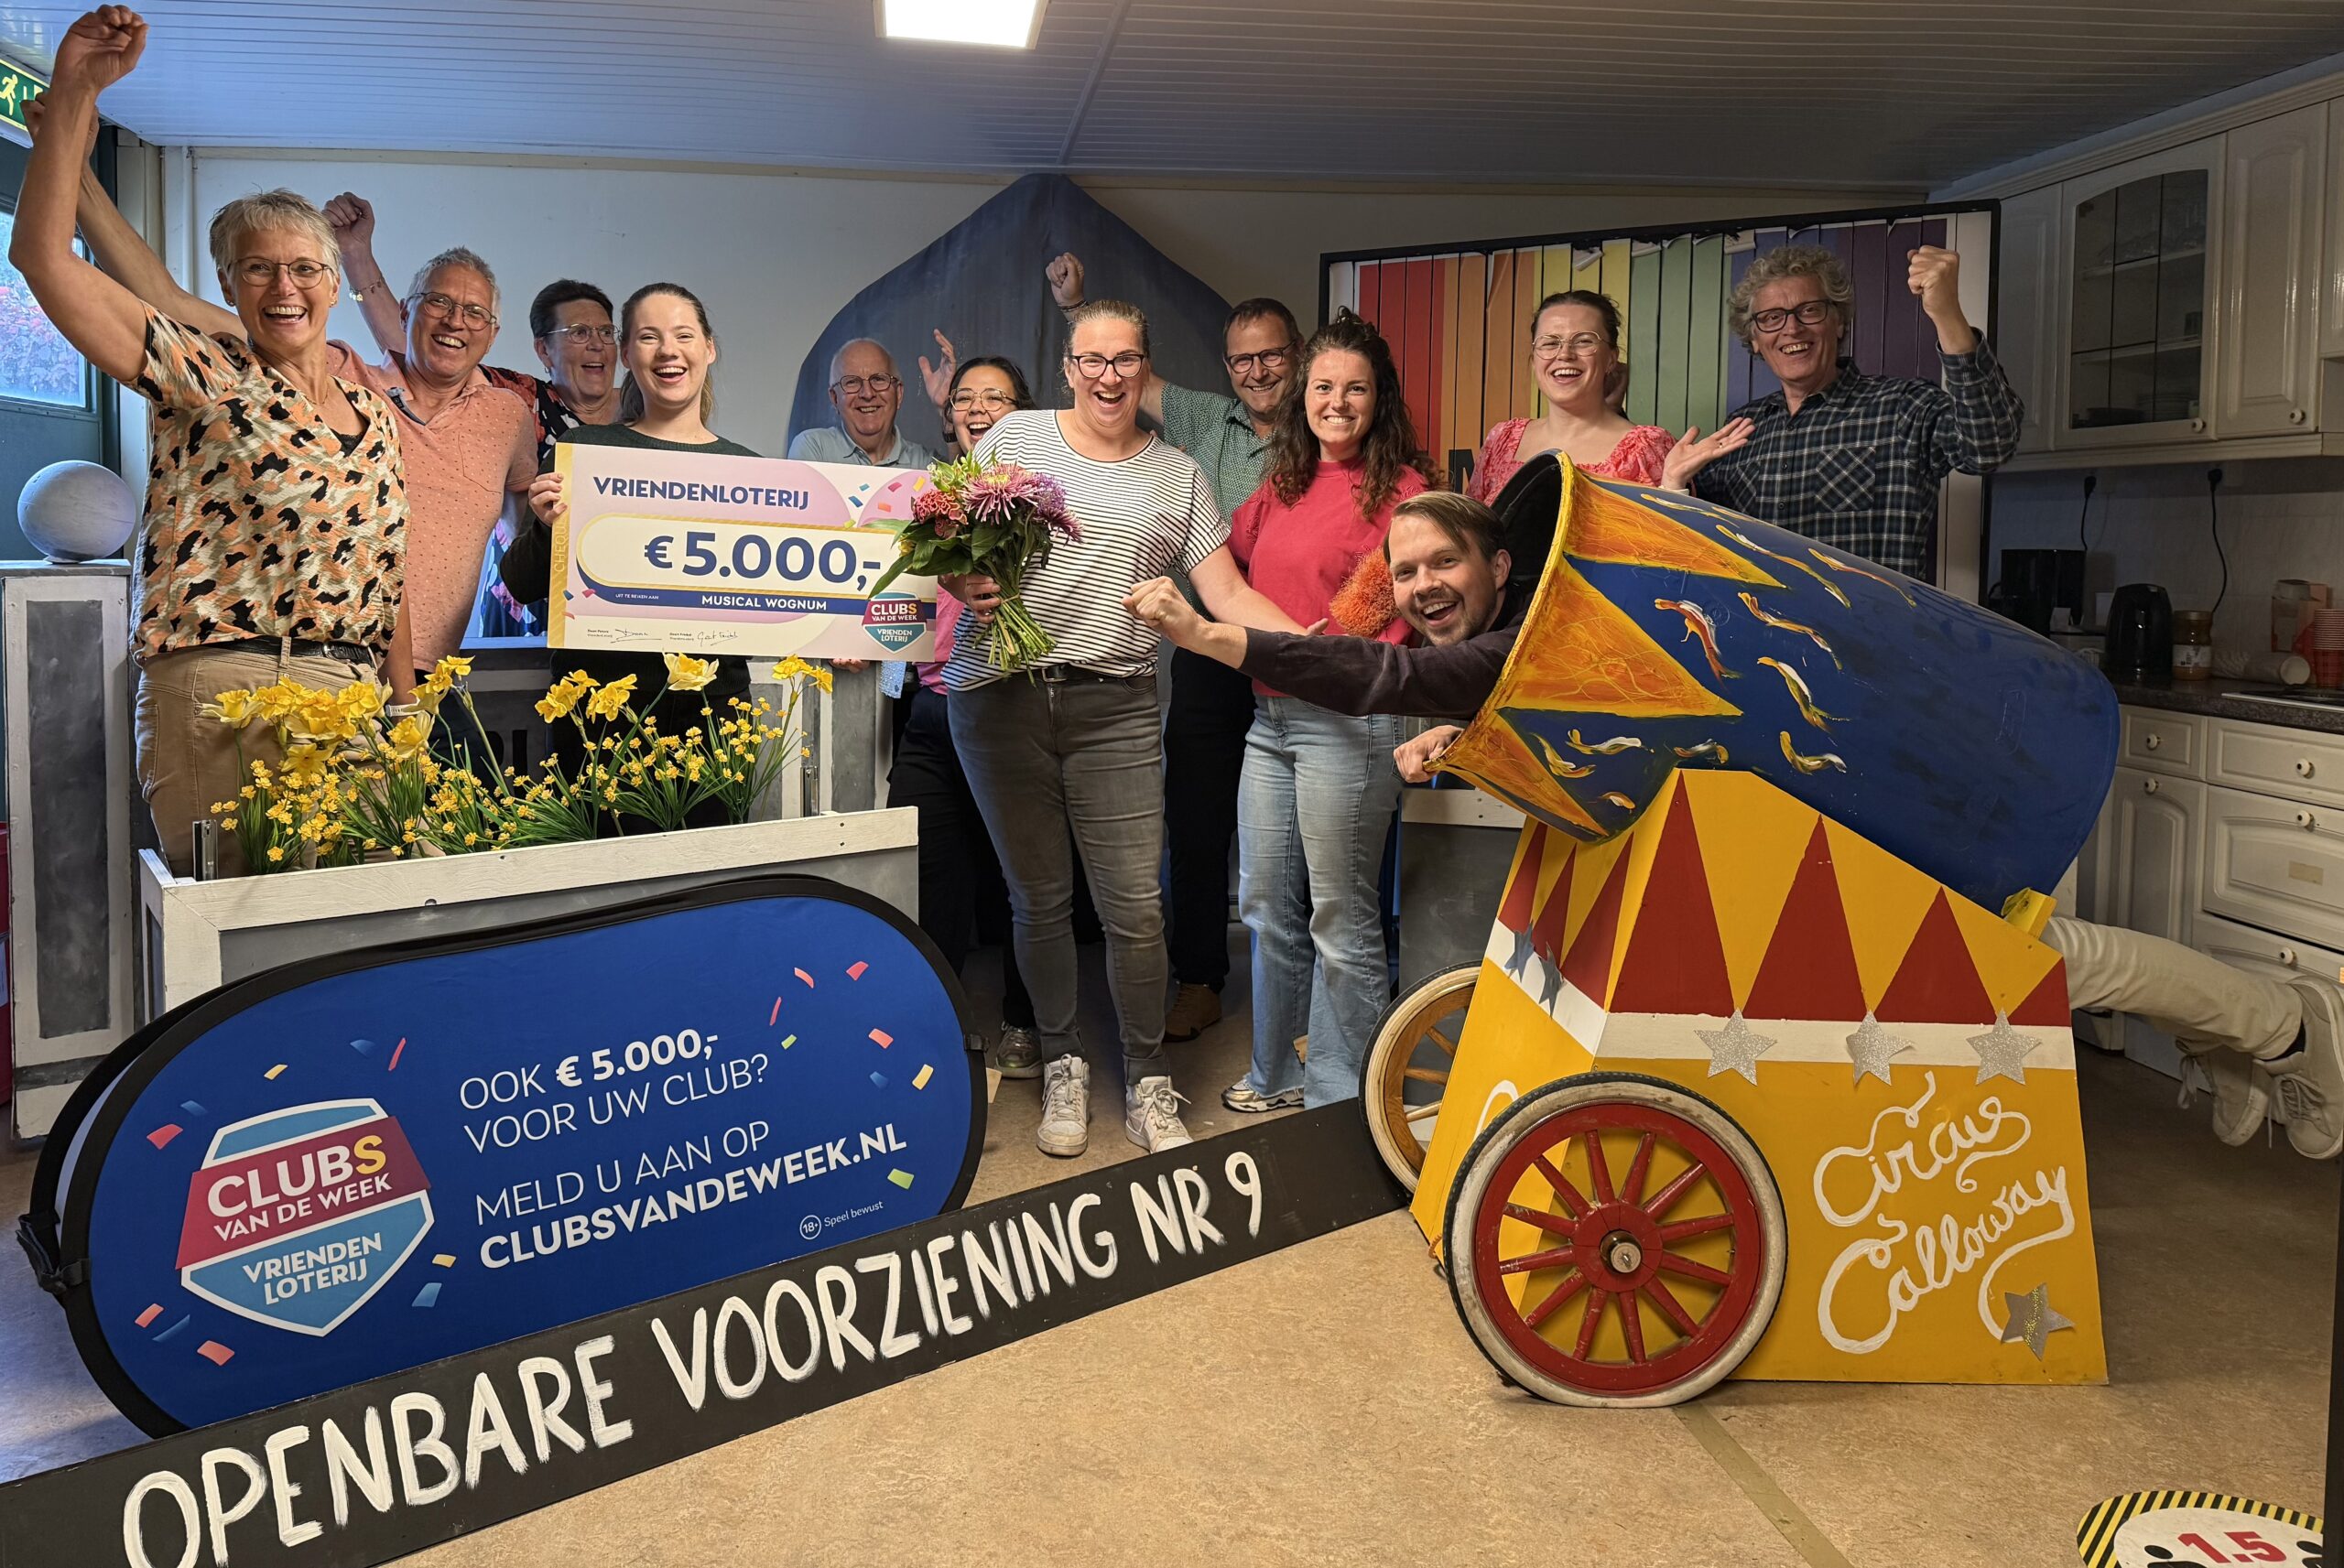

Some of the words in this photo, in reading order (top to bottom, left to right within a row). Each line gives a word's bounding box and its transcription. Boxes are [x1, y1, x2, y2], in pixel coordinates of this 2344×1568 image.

[592, 476, 809, 511] VRIENDENLOTERIJ
[553, 519, 569, 573] CHEQU
[644, 535, 675, 569] €
[681, 531, 882, 591] 5.000,-
[701, 595, 762, 608] MUSICAL
[765, 598, 827, 611] WOGNUM
[870, 602, 917, 616] CLUBS
[877, 628, 913, 636] VRIENDEN
[881, 634, 908, 643] LOTERIJ
[460, 1064, 547, 1109] OOK
[555, 1055, 583, 1087] €
[591, 1028, 719, 1082] 5.000,-
[463, 1102, 578, 1154] VOOR
[588, 1082, 651, 1125] UW
[663, 1054, 769, 1106] CLUB?
[207, 1134, 387, 1218] CLUBS
[476, 1170, 585, 1227] MELD
[596, 1158, 623, 1194] U
[635, 1135, 713, 1185] AAN
[722, 1119, 771, 1158] OP
[1814, 1070, 2032, 1227] Circus
[213, 1209, 270, 1242] VAN
[277, 1196, 313, 1224] DE
[317, 1172, 394, 1210] WEEK
[479, 1122, 908, 1270] CLUBSVANDEWEEK.NL
[824, 1209, 850, 1227] Speel
[850, 1200, 884, 1218] bewust
[243, 1231, 383, 1284] VRIENDEN
[264, 1258, 368, 1305] LOTERIJ
[1818, 1165, 2076, 1355] Calloway
[123, 1335, 635, 1568] OPENBARE
[650, 1192, 1119, 1412] VOORZIENING
[1129, 1168, 1227, 1265] NR
[1225, 1151, 1263, 1238] 9
[2176, 1530, 2287, 1564] 1.5
